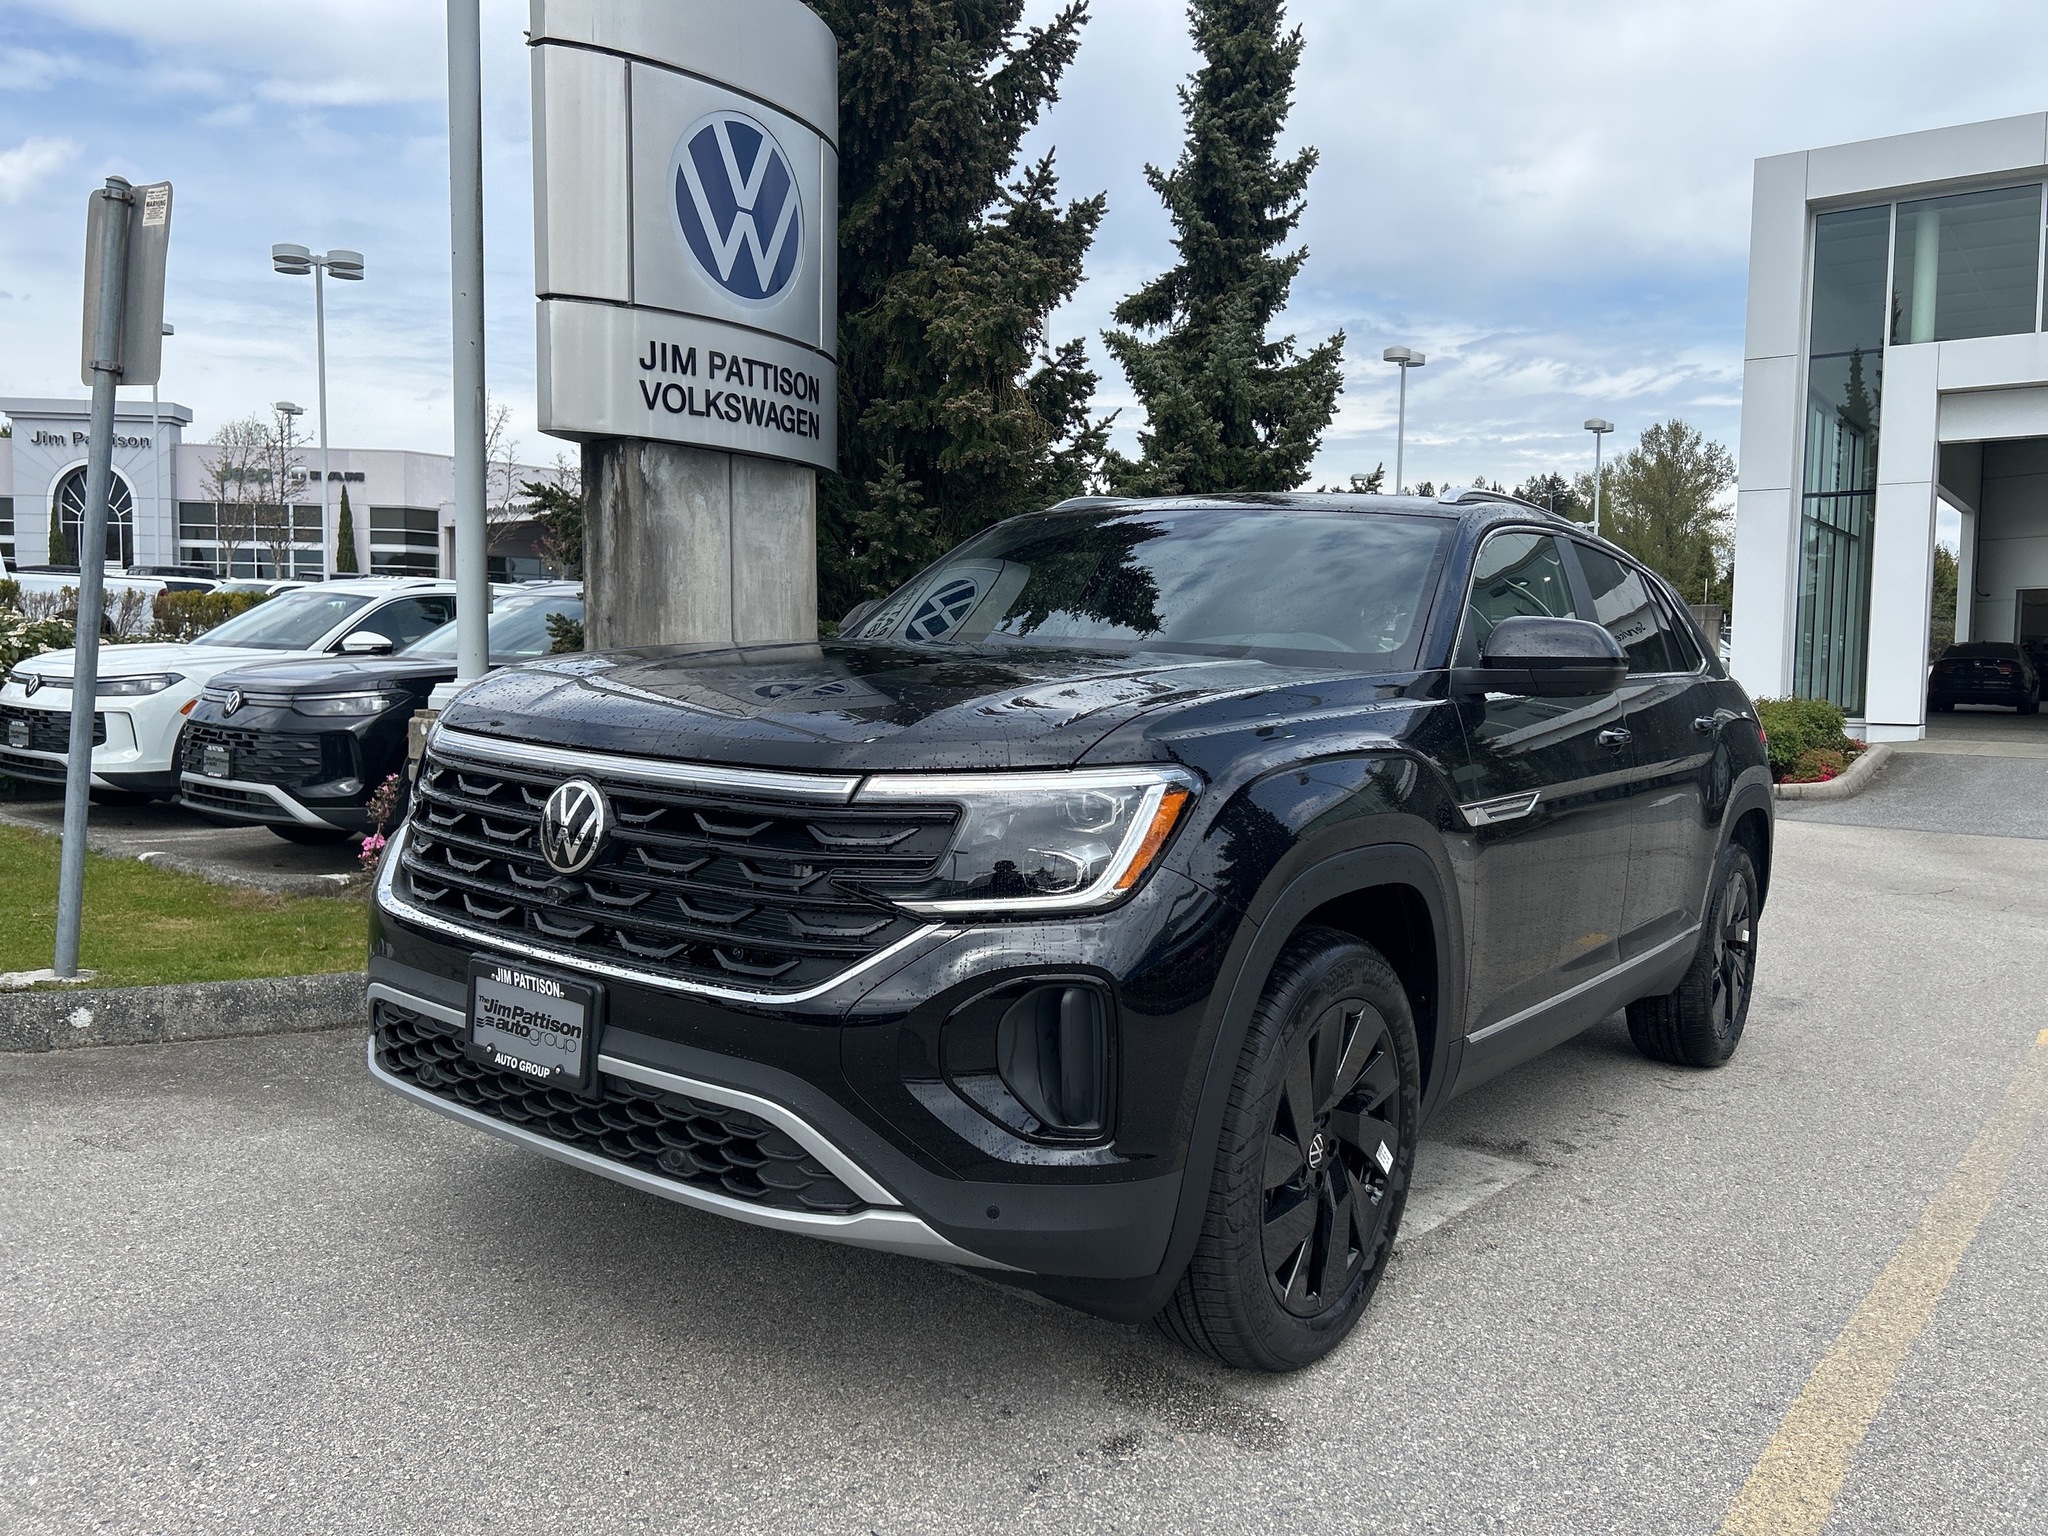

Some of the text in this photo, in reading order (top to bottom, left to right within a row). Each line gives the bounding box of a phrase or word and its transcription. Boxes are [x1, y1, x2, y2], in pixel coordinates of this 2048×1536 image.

[639, 340, 820, 405] JIM PATTISON
[639, 380, 820, 440] VOLKSWAGEN
[31, 430, 152, 449] Jim Paison
[495, 967, 560, 998] JIM PATTISON
[494, 1053, 550, 1079] AUTO GROUP
